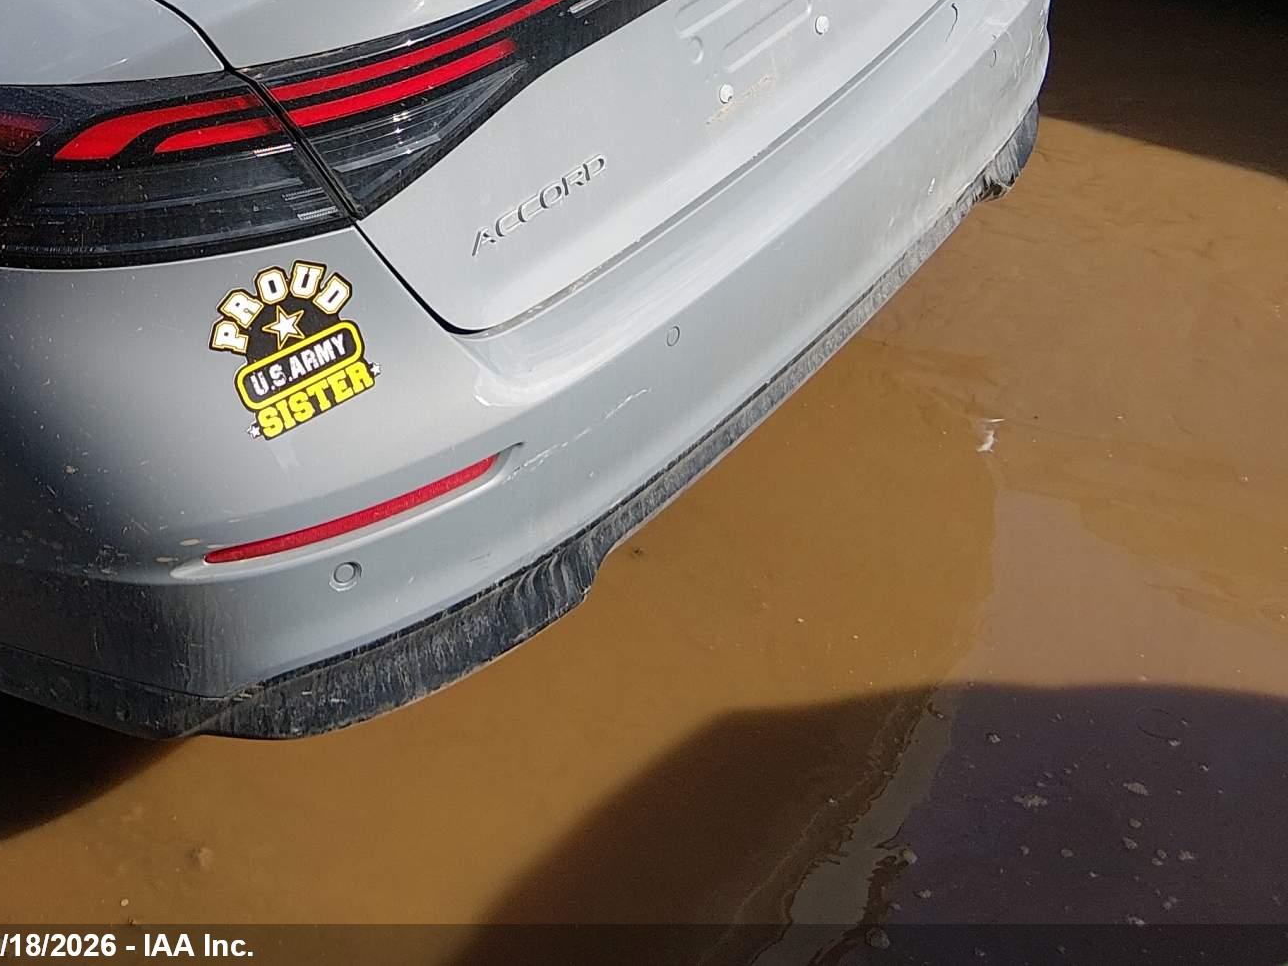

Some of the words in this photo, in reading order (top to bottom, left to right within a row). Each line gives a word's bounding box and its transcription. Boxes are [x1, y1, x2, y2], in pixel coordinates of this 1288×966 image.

[471, 155, 606, 257] ACCORD
[211, 262, 351, 354] PROUD
[257, 361, 375, 438] SISTER
